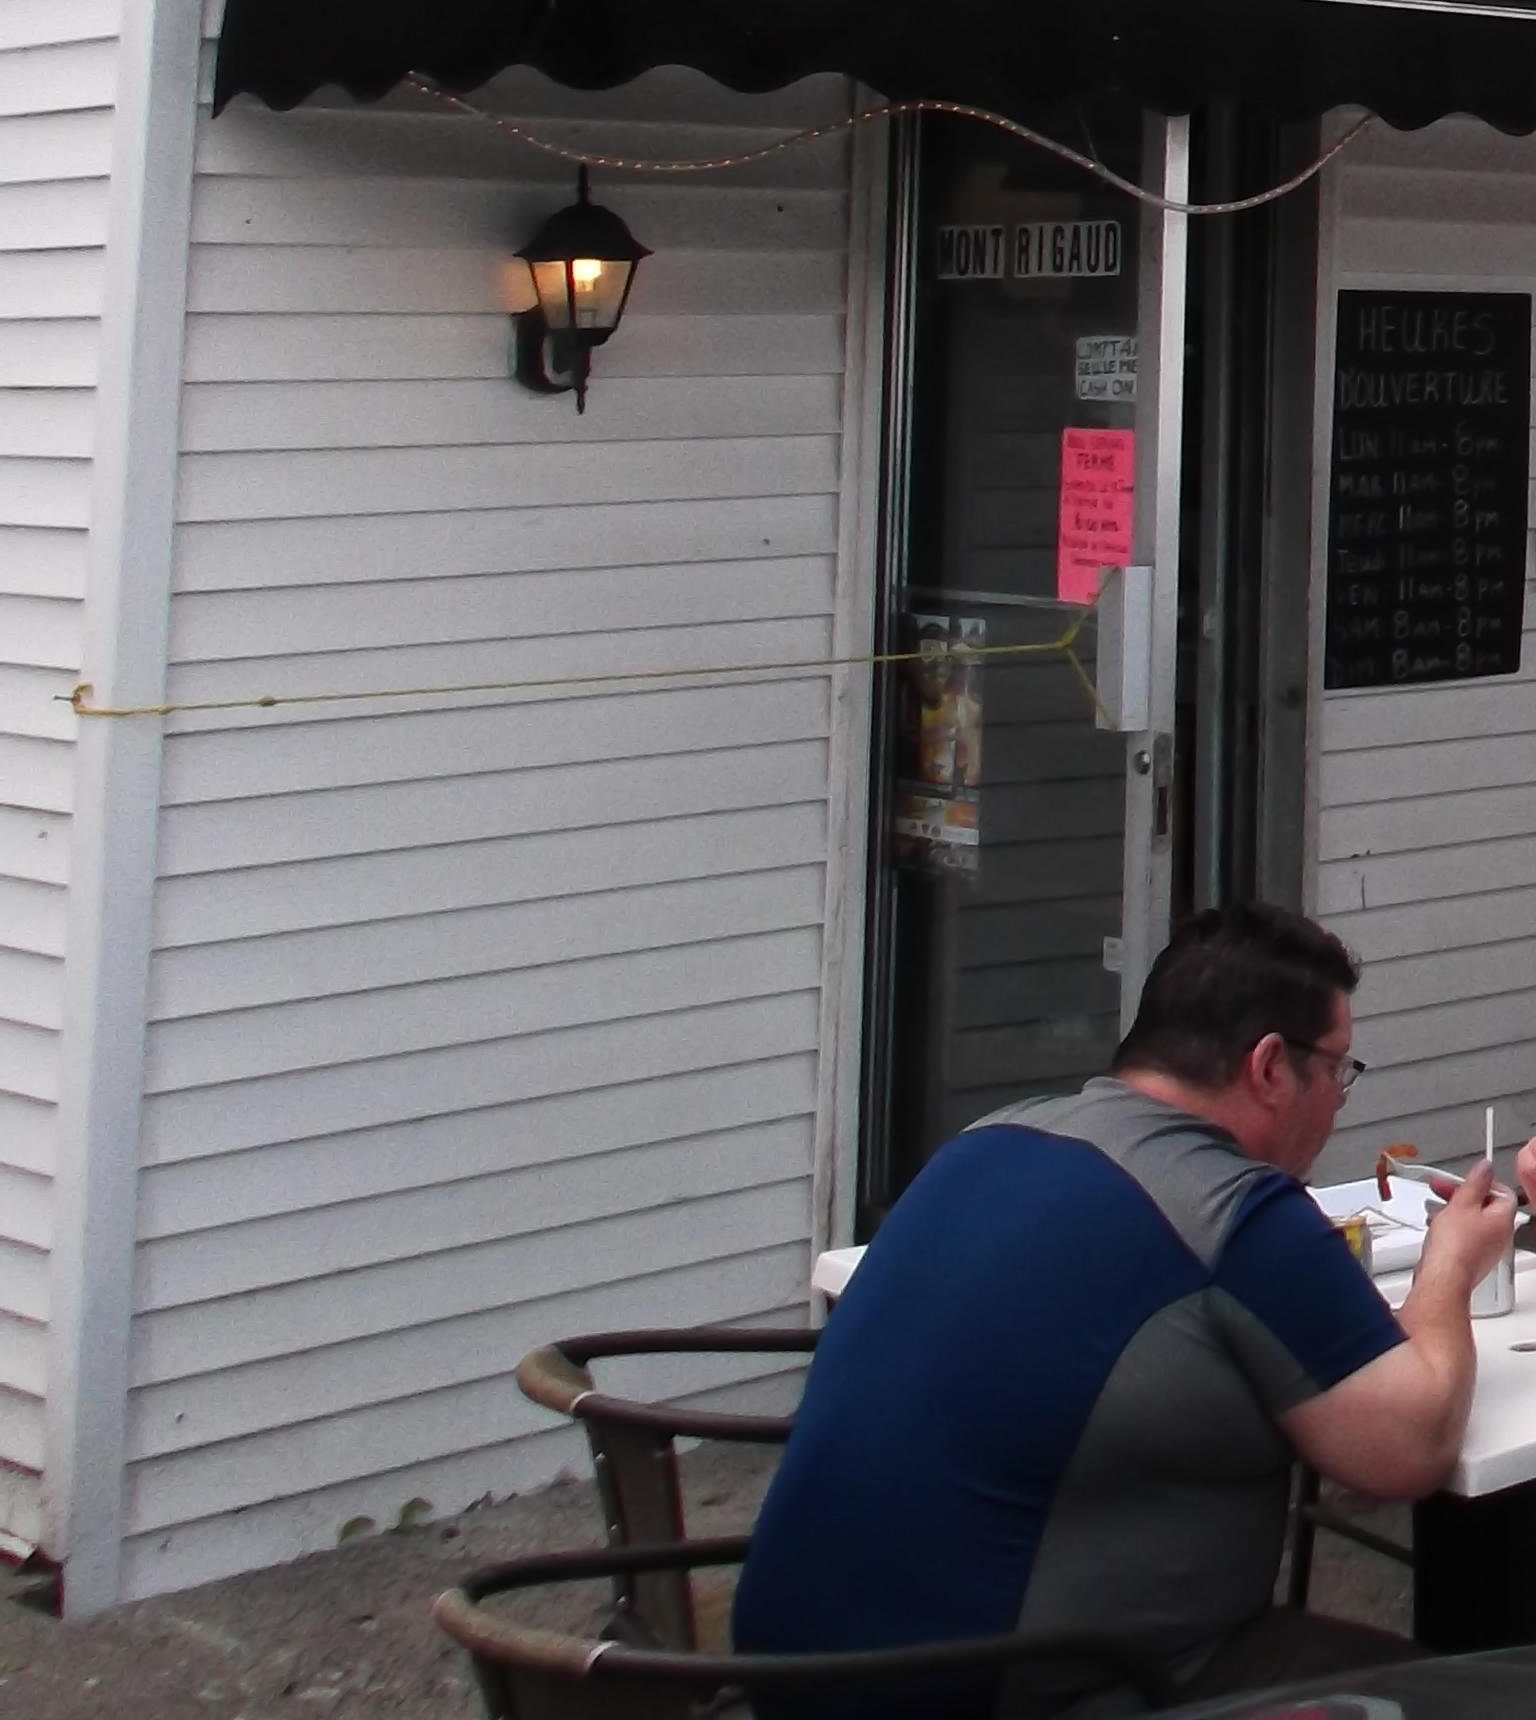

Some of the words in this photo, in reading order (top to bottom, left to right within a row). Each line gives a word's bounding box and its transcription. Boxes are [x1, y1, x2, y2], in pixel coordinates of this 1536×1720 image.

[940, 227, 1004, 276] MONT
[1017, 222, 1119, 274] RIGAUD
[1358, 305, 1497, 356] HEURES
[1338, 428, 1382, 461] LUN
